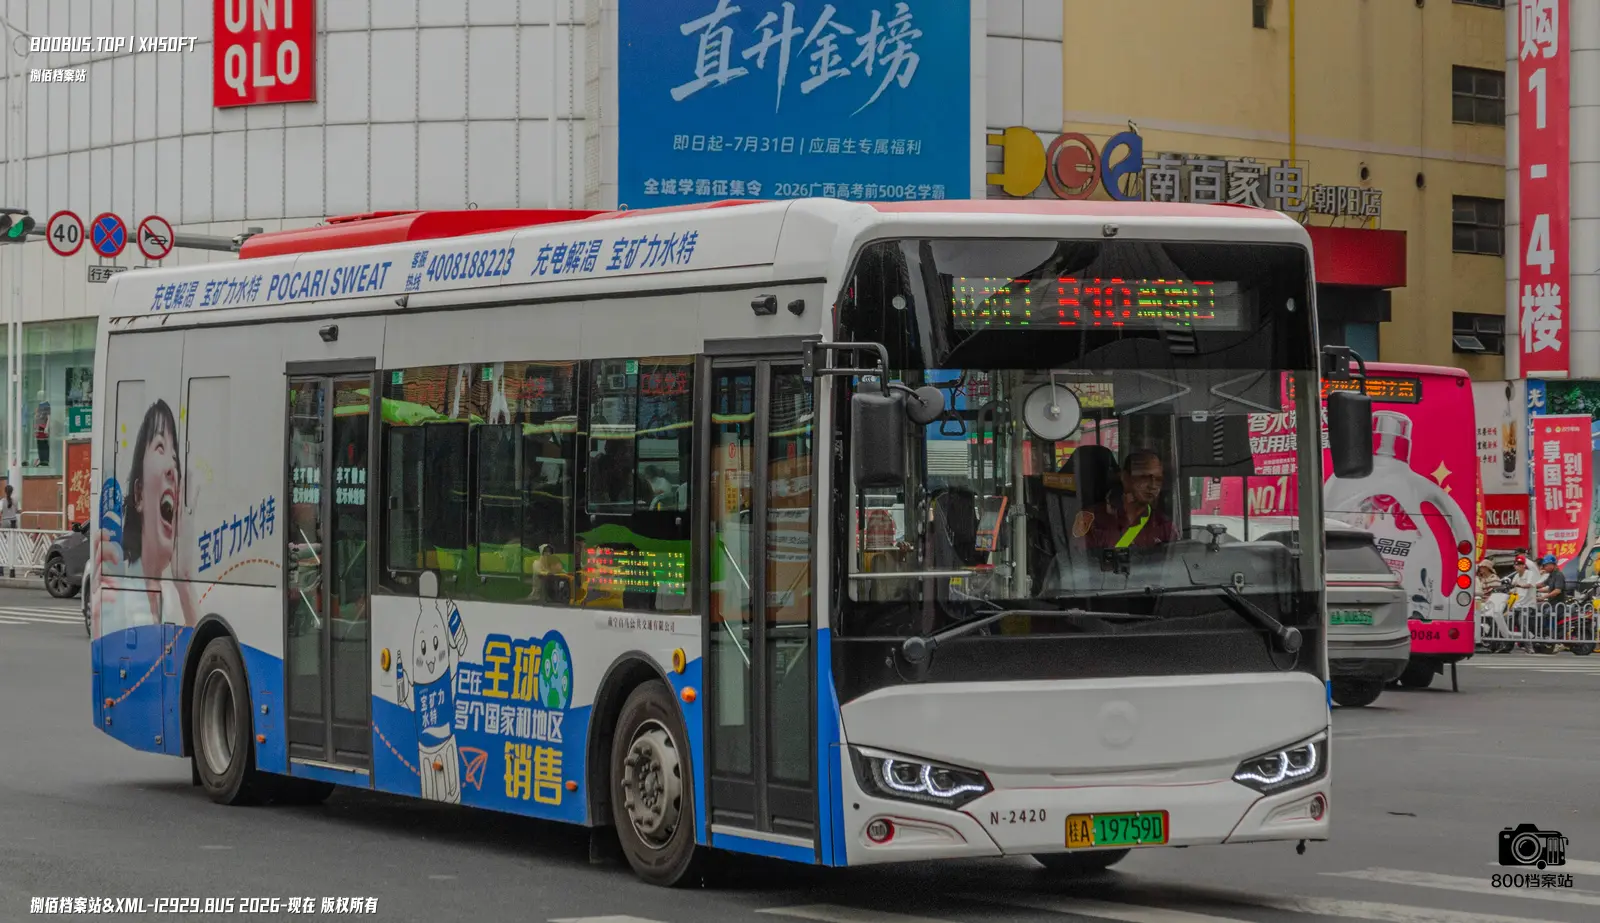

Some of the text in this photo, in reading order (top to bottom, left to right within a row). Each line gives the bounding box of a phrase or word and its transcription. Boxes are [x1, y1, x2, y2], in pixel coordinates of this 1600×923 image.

[224, 0, 294, 33] UNI
[224, 39, 300, 97] QLO
[670, 0, 923, 117] 直升金榜
[643, 178, 946, 200] 全城学霸征集令 2026广西高考前500名学霸
[1143, 154, 1307, 213] 南百家电
[1310, 185, 1383, 217] 朝阳店
[53, 223, 79, 243] 40
[531, 229, 699, 277] 充电解渴 宝矿力水特
[91, 268, 126, 281] 行车
[151, 261, 392, 311] 充电解渴 宝矿力水特 POCARI SWEAT
[426, 247, 516, 283] 4008188223
[198, 494, 277, 573] 宝矿力水特
[455, 699, 564, 744] 多个国家和地区
[504, 741, 563, 806] 销售
[990, 808, 1047, 825] N-2420
